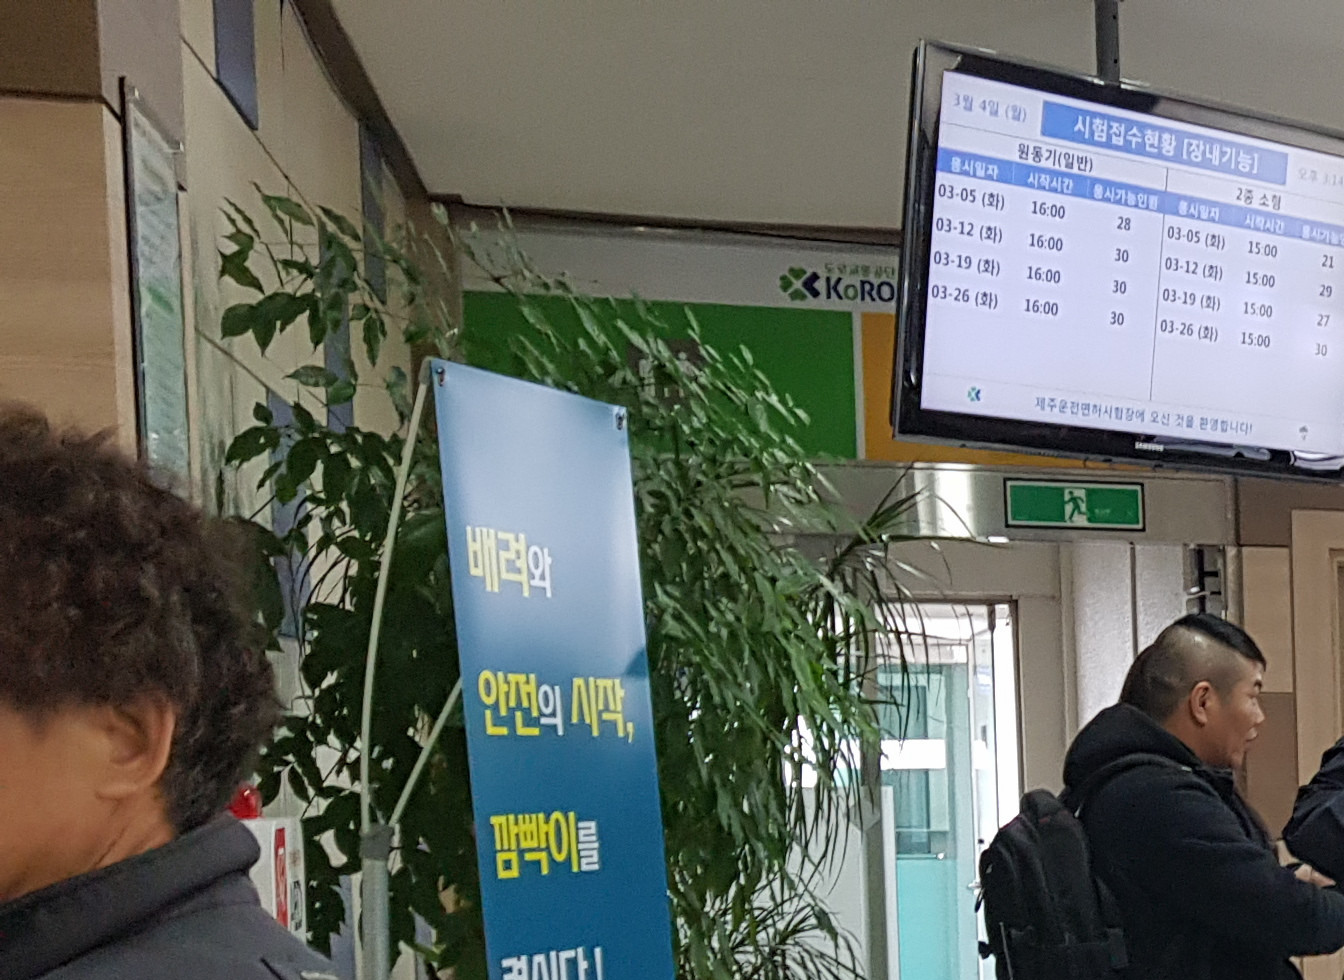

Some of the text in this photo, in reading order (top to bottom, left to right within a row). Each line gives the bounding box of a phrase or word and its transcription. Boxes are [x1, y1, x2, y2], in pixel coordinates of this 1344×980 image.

[1073, 114, 1259, 174] 시험접수현황 [장내기능]
[1017, 143, 1093, 173] 원동기(일반)
[1027, 172, 1074, 194] 시작시간
[938, 183, 1005, 211] 03-05 (화)
[1031, 200, 1066, 219] 16:00
[935, 217, 1003, 244] 03-12 (화)
[1116, 216, 1131, 231] 28
[1029, 233, 1063, 252] 16:00
[1167, 226, 1225, 250] 03-05 (화)
[1114, 248, 1129, 263] 30
[1248, 240, 1278, 258] 15:00
[933, 251, 1000, 277] 03-19 (화)
[1165, 257, 1223, 281] 03-12 (화)
[1322, 254, 1334, 269] 21
[1026, 266, 1061, 284] 16:00
[1245, 271, 1275, 288] 15:00
[931, 284, 998, 310] 03-26 (화)
[1112, 280, 1127, 295] 30
[1319, 284, 1332, 298] 29
[1024, 299, 1058, 316] 16:00
[1162, 288, 1220, 311] 03-19 (화)
[1110, 312, 1124, 326] 30
[1243, 301, 1273, 318] 15:00
[1317, 314, 1330, 327] 27
[1160, 319, 1218, 342] 03-26 (화)
[1241, 332, 1270, 348] 15:00
[1315, 343, 1328, 356] 30
[466, 524, 553, 598] 배려와
[478, 669, 635, 743] 안전의 시작,
[490, 793, 600, 880] 깜빡이를
